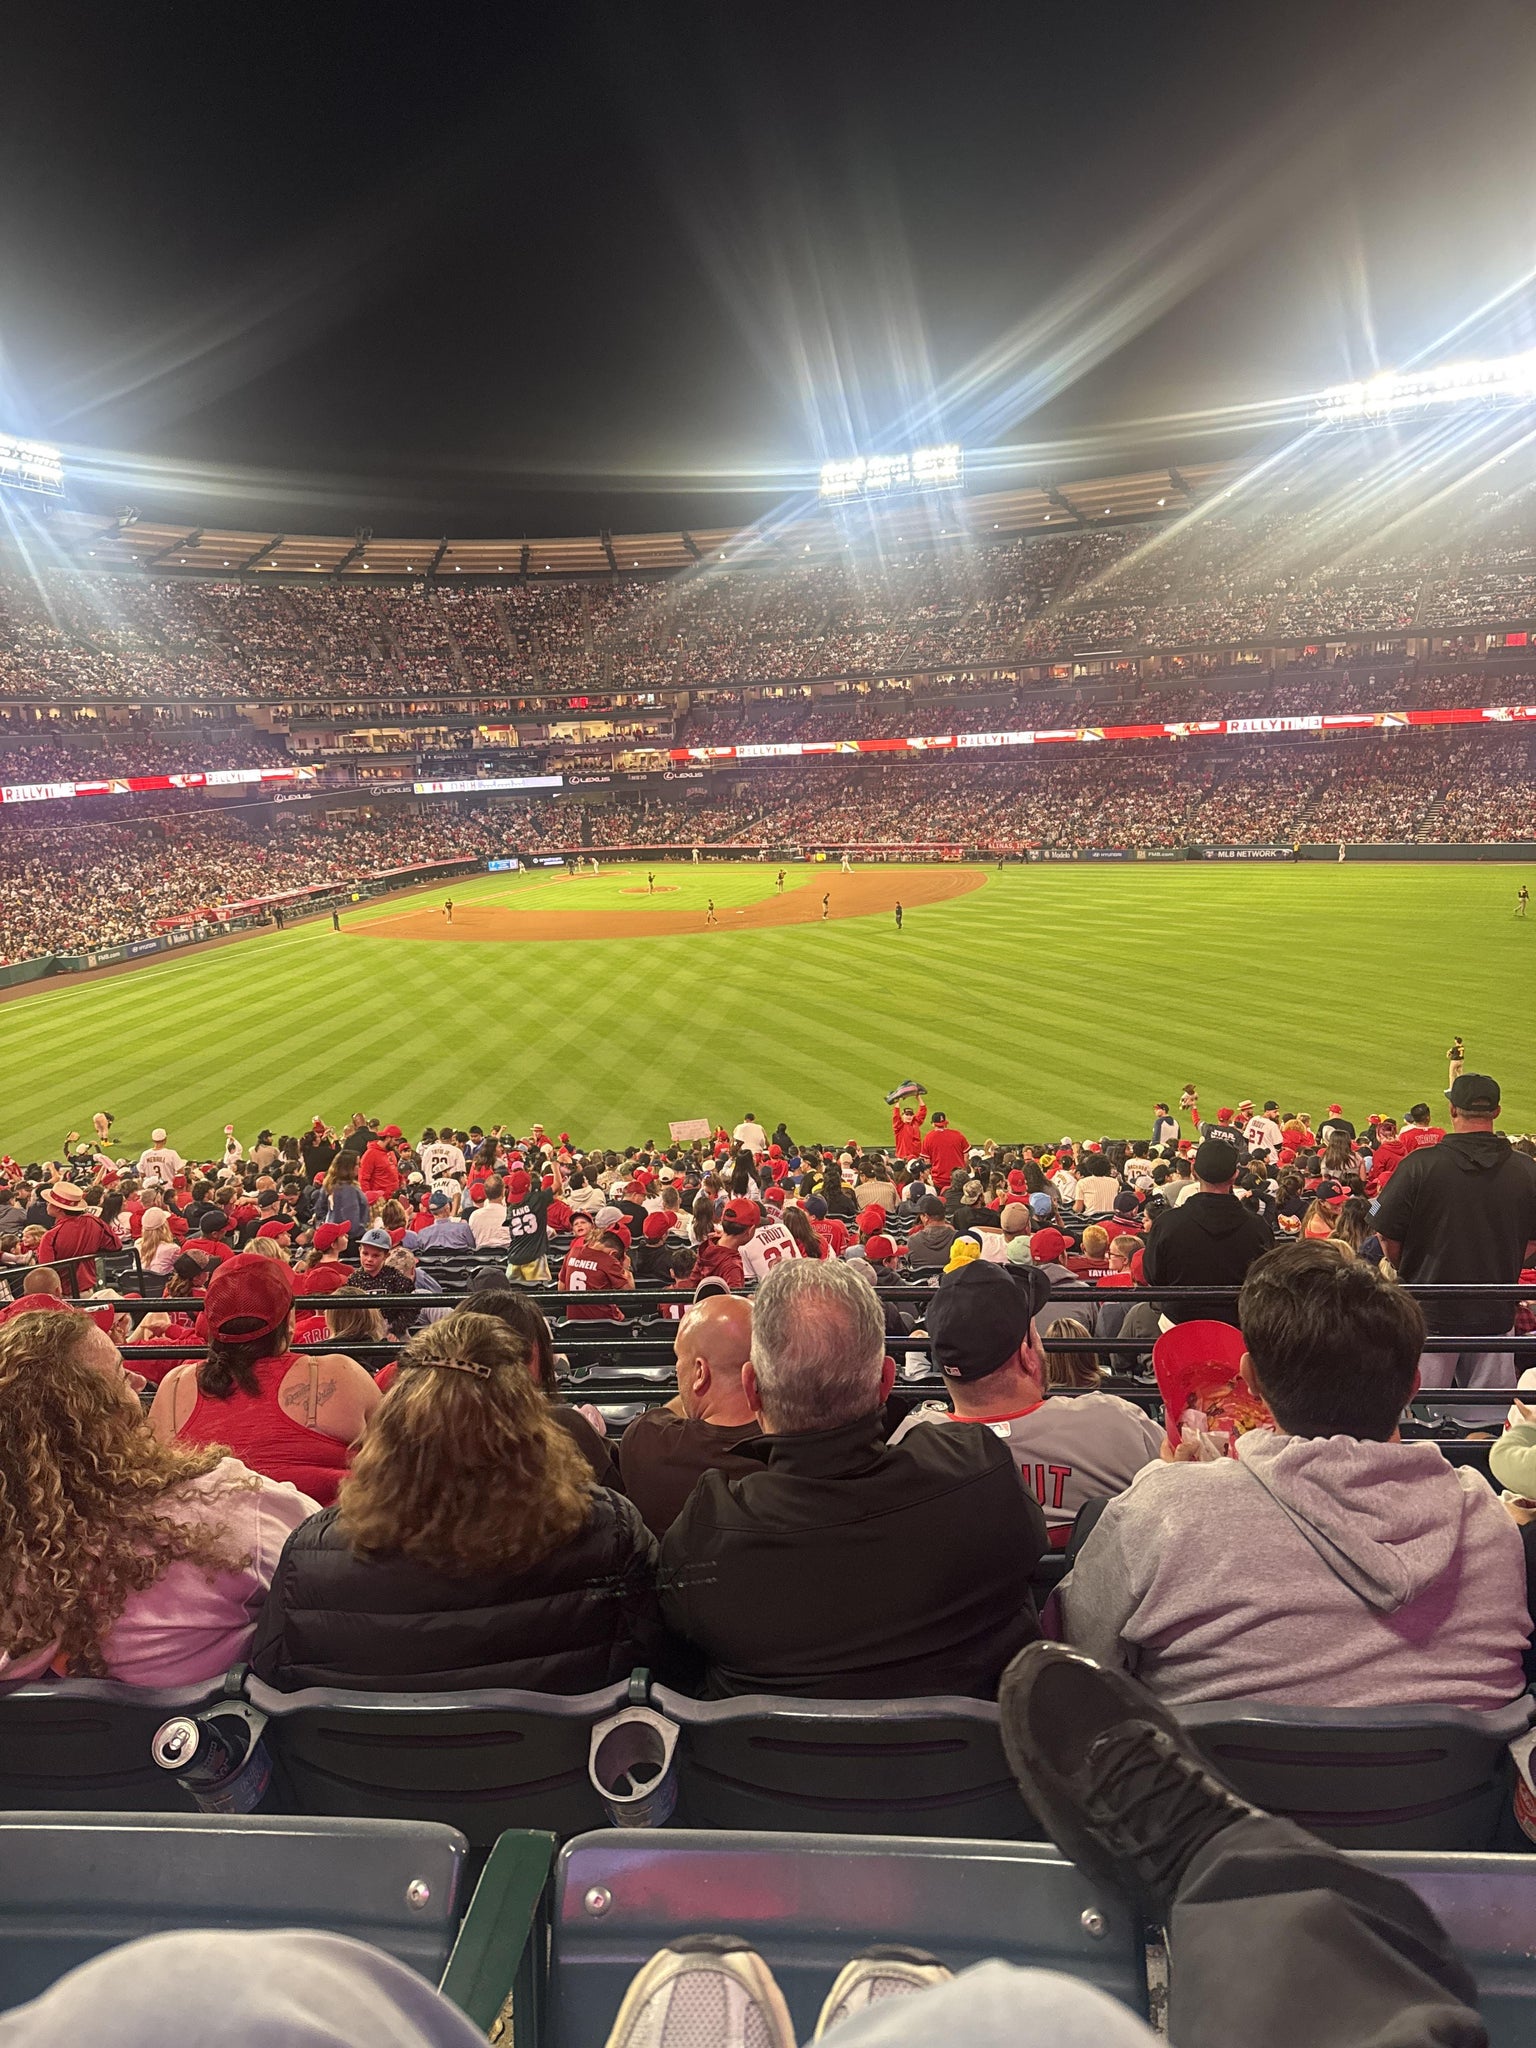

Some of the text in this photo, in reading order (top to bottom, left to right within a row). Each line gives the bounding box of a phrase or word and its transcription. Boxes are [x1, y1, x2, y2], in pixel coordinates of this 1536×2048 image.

[674, 771, 704, 779] LEXUS
[1051, 851, 1071, 859] Modelo
[1217, 849, 1277, 858] MLB NETWORK
[1210, 1129, 1236, 1141] STAR
[1249, 1128, 1265, 1146] 27
[512, 1205, 531, 1217] LANG
[511, 1213, 538, 1236] 23
[756, 1227, 785, 1246] TROUT
[763, 1239, 797, 1269] 27
[569, 1271, 588, 1291] 6
